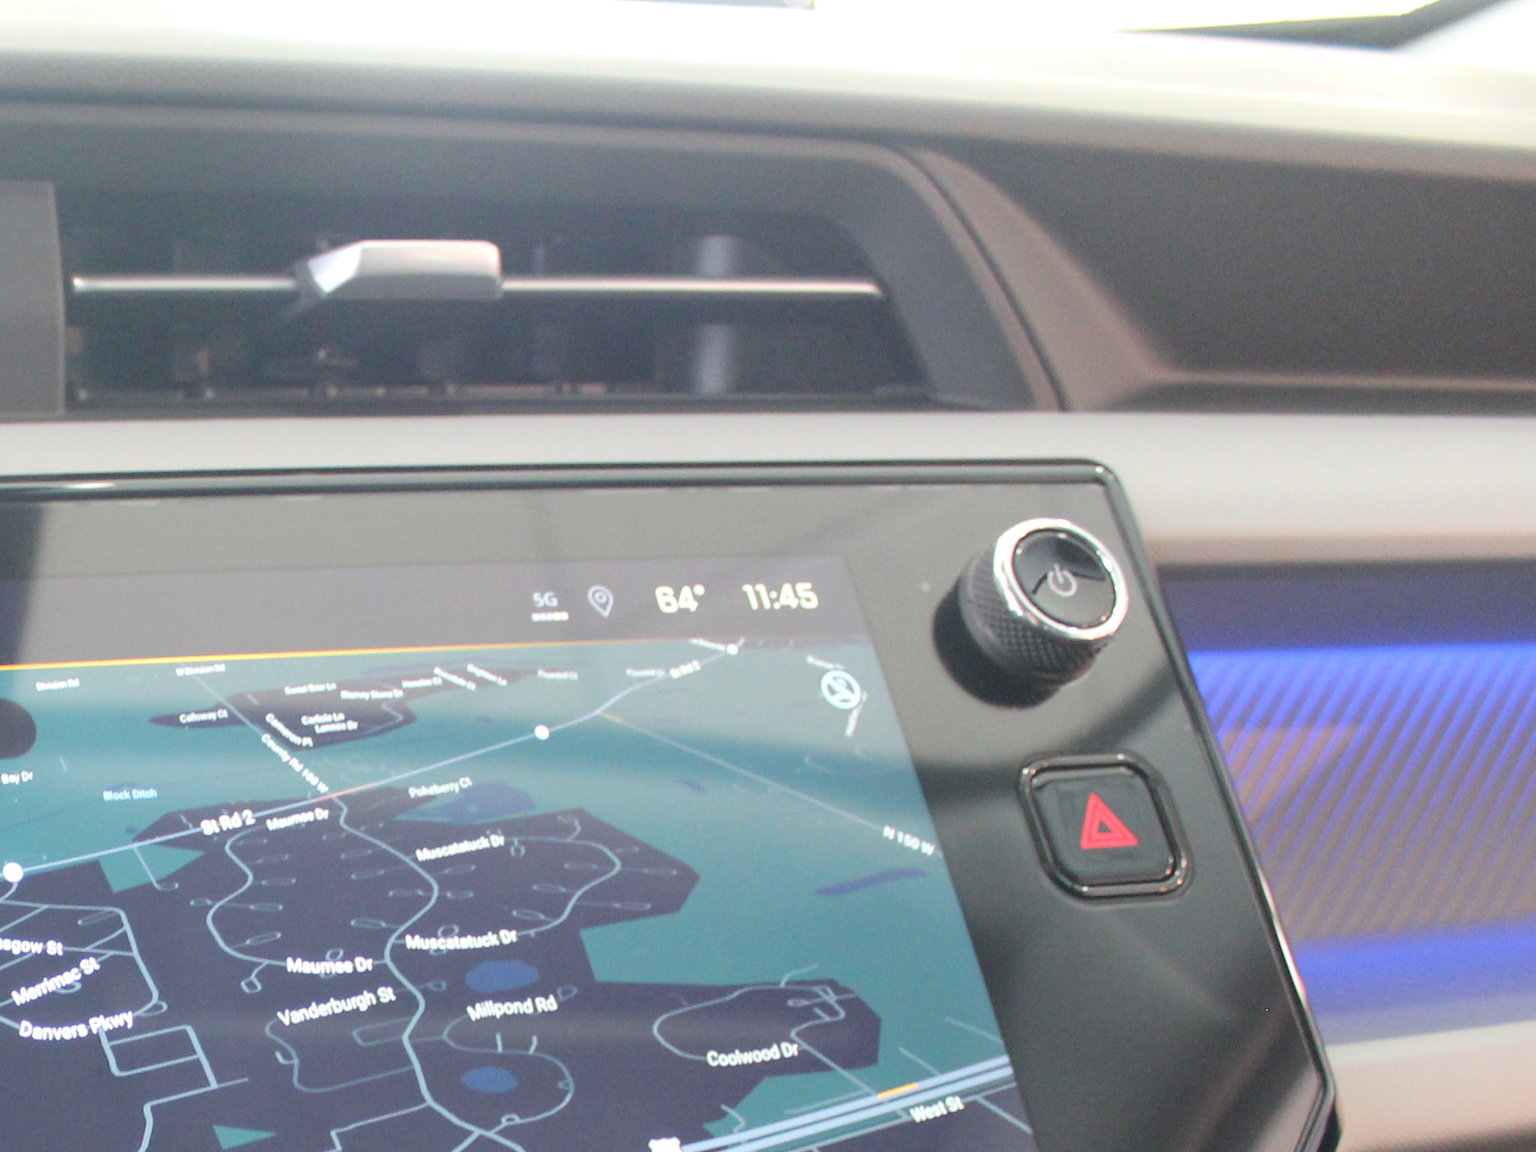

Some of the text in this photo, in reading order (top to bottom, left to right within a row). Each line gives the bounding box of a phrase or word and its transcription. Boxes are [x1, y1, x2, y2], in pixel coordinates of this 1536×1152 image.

[532, 591, 558, 607] 5G
[742, 582, 819, 610] 11:45
[1, 773, 20, 785] Bay
[20, 770, 33, 782] Dr
[289, 757, 304, 772] Rd
[302, 768, 319, 786] 100
[459, 776, 473, 789] Ct
[200, 809, 256, 836] St Rd 2
[266, 807, 329, 831] Maumee Dr
[415, 834, 505, 862] Muscatatuck Dr
[46, 939, 64, 957] St
[405, 929, 518, 951] Muscatatuck Dr
[286, 956, 374, 975] Maumee Dr
[11, 956, 101, 1006] Merrimac St
[277, 986, 397, 1027] Vanderburgh St
[466, 994, 559, 1022] Millpond Rd
[19, 1010, 134, 1041] Danvers Pkwy
[706, 1042, 799, 1069] Coolwood Dr
[909, 1095, 964, 1124] West St
